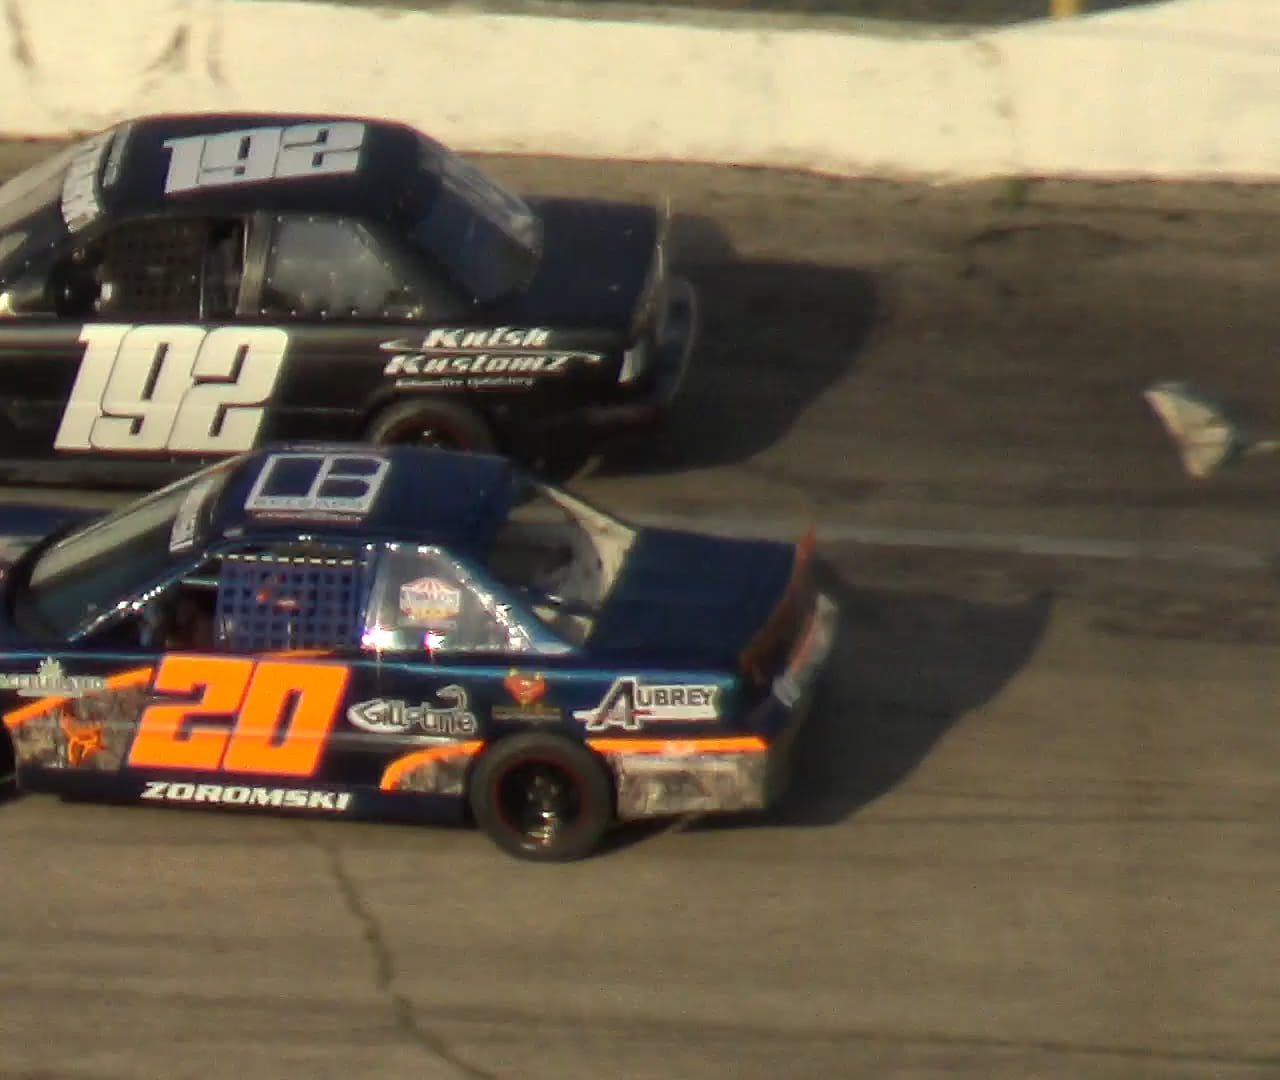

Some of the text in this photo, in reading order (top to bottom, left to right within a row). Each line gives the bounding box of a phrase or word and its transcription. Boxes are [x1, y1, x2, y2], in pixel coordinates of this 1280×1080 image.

[163, 121, 365, 194] 192
[53, 323, 289, 452] 192
[127, 654, 351, 778] 20
[139, 781, 352, 811] ZOROMSKI
